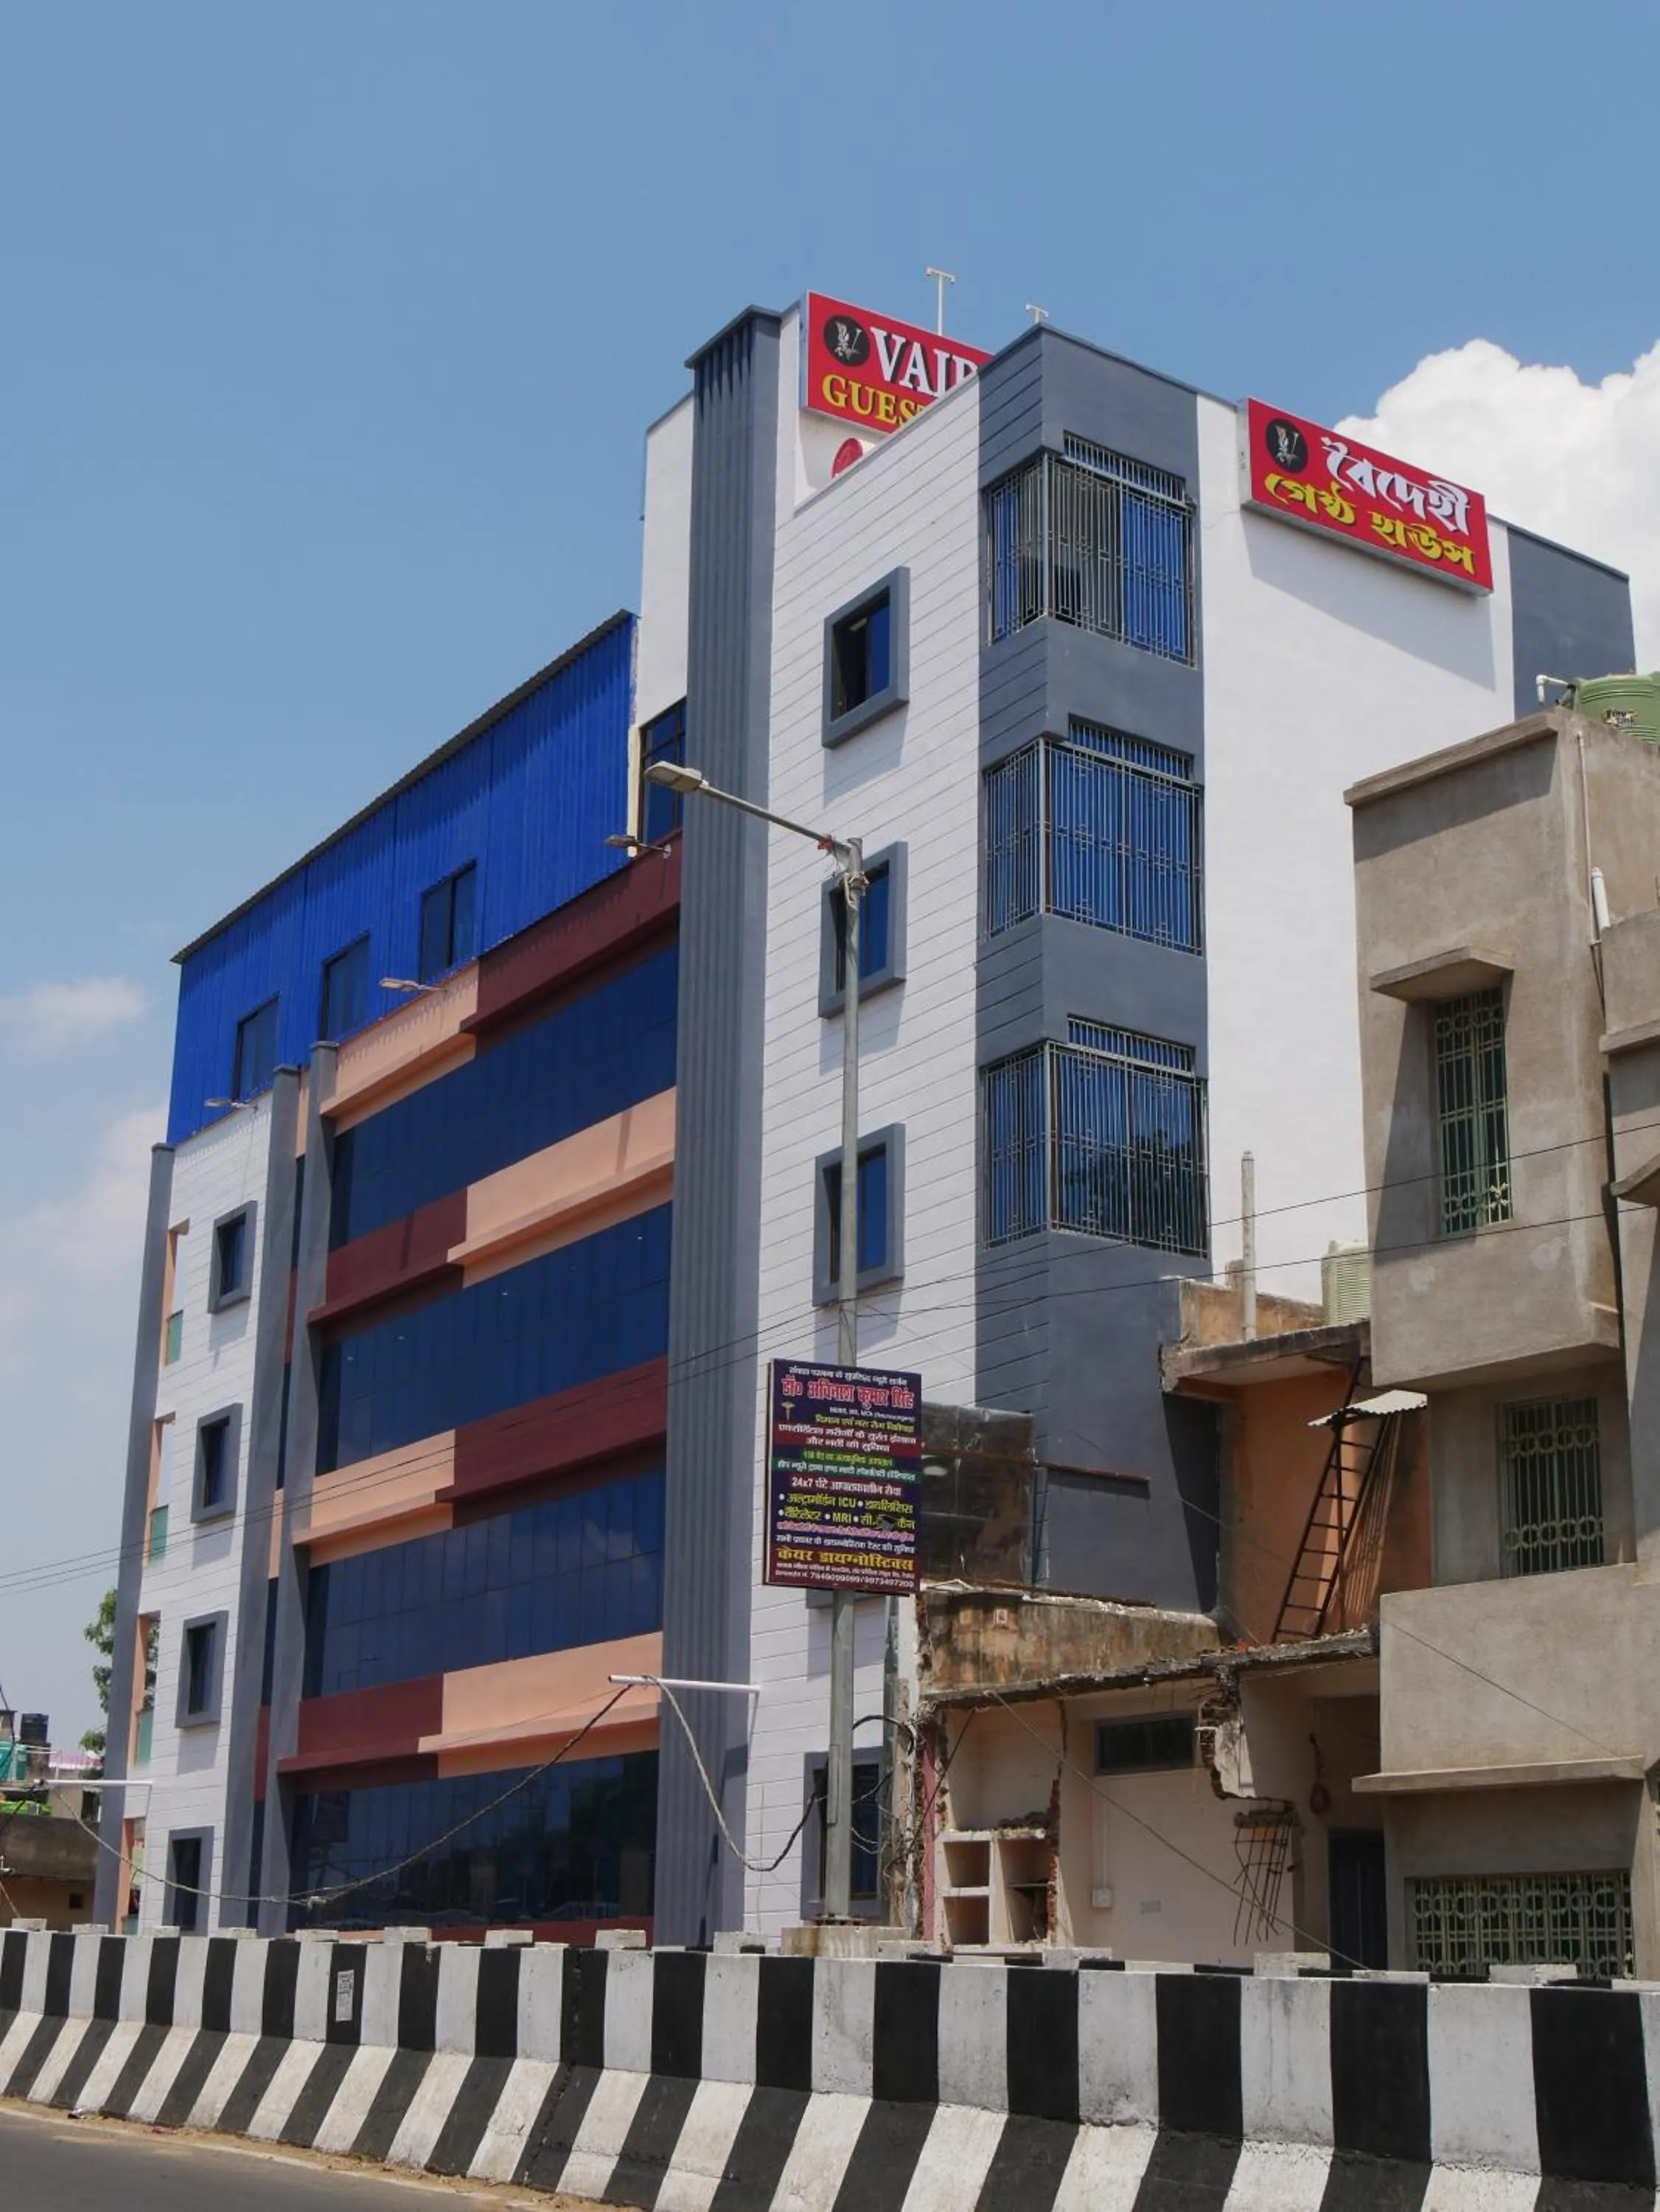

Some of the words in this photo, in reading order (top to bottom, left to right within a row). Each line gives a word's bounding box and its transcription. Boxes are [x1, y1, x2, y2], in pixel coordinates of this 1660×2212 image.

[821, 373, 925, 425] GUES
[1320, 436, 1471, 535] বৈদেহী
[1369, 511, 1476, 575] হাউস
[857, 1387, 889, 1411] कुमार
[891, 1386, 914, 1409] सिंह
[792, 1477, 812, 1487] 24x7
[885, 1484, 901, 1495] सेवा
[838, 1498, 856, 1508] ICU
[833, 1513, 851, 1523] MRI
[776, 1545, 813, 1561] केयर
